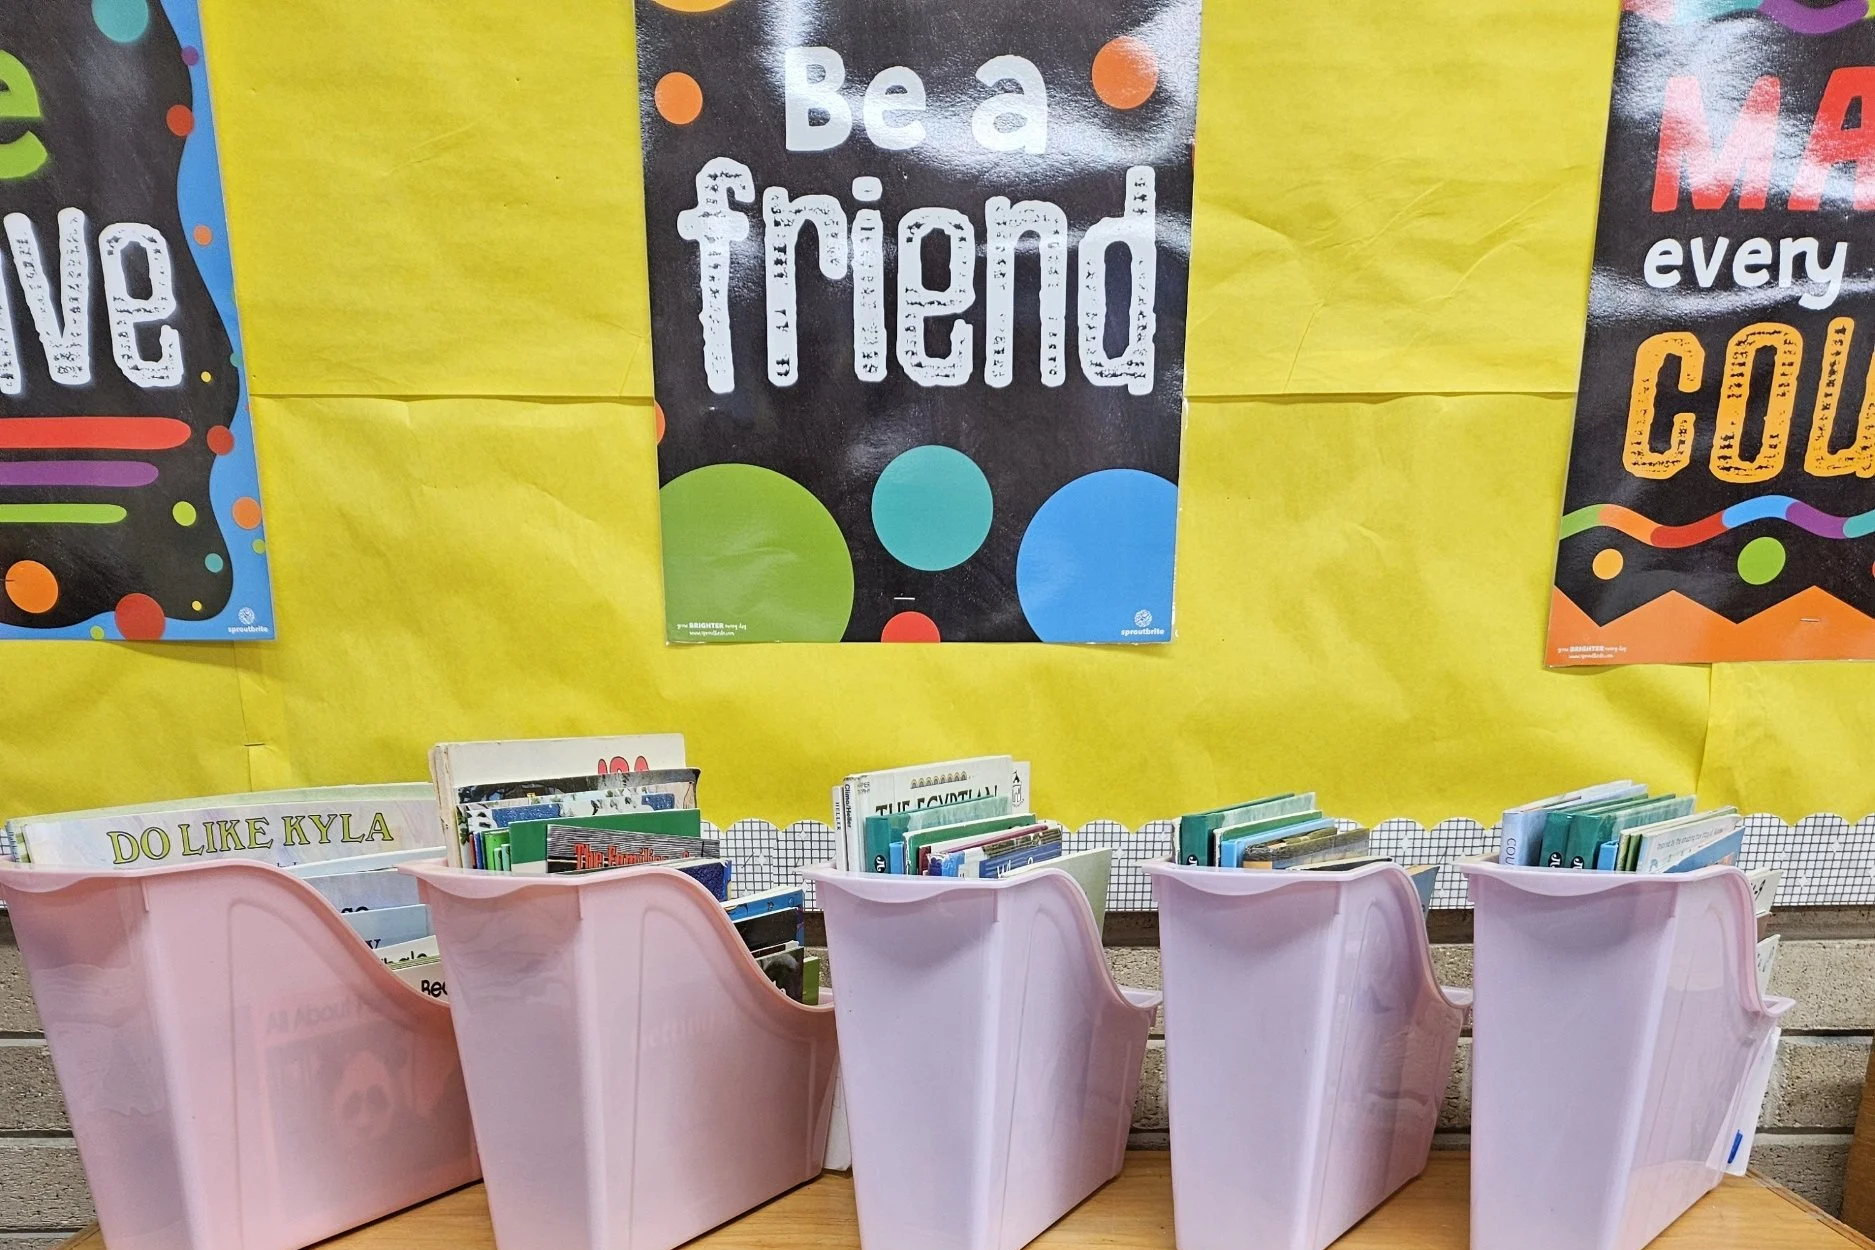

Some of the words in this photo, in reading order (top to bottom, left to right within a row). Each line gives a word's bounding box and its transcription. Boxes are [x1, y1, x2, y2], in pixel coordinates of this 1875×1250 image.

[784, 46, 927, 151] Be
[972, 54, 1048, 154] a
[0, 206, 184, 394] ve
[677, 157, 1157, 395] friend
[1643, 236, 1848, 310] every
[1120, 628, 1165, 636] sproutbrite
[844, 783, 853, 829] Climo/Heller
[106, 825, 171, 865] DO
[177, 816, 274, 856] LIKE
[281, 812, 395, 847] KYLA
[574, 843, 604, 871] The
